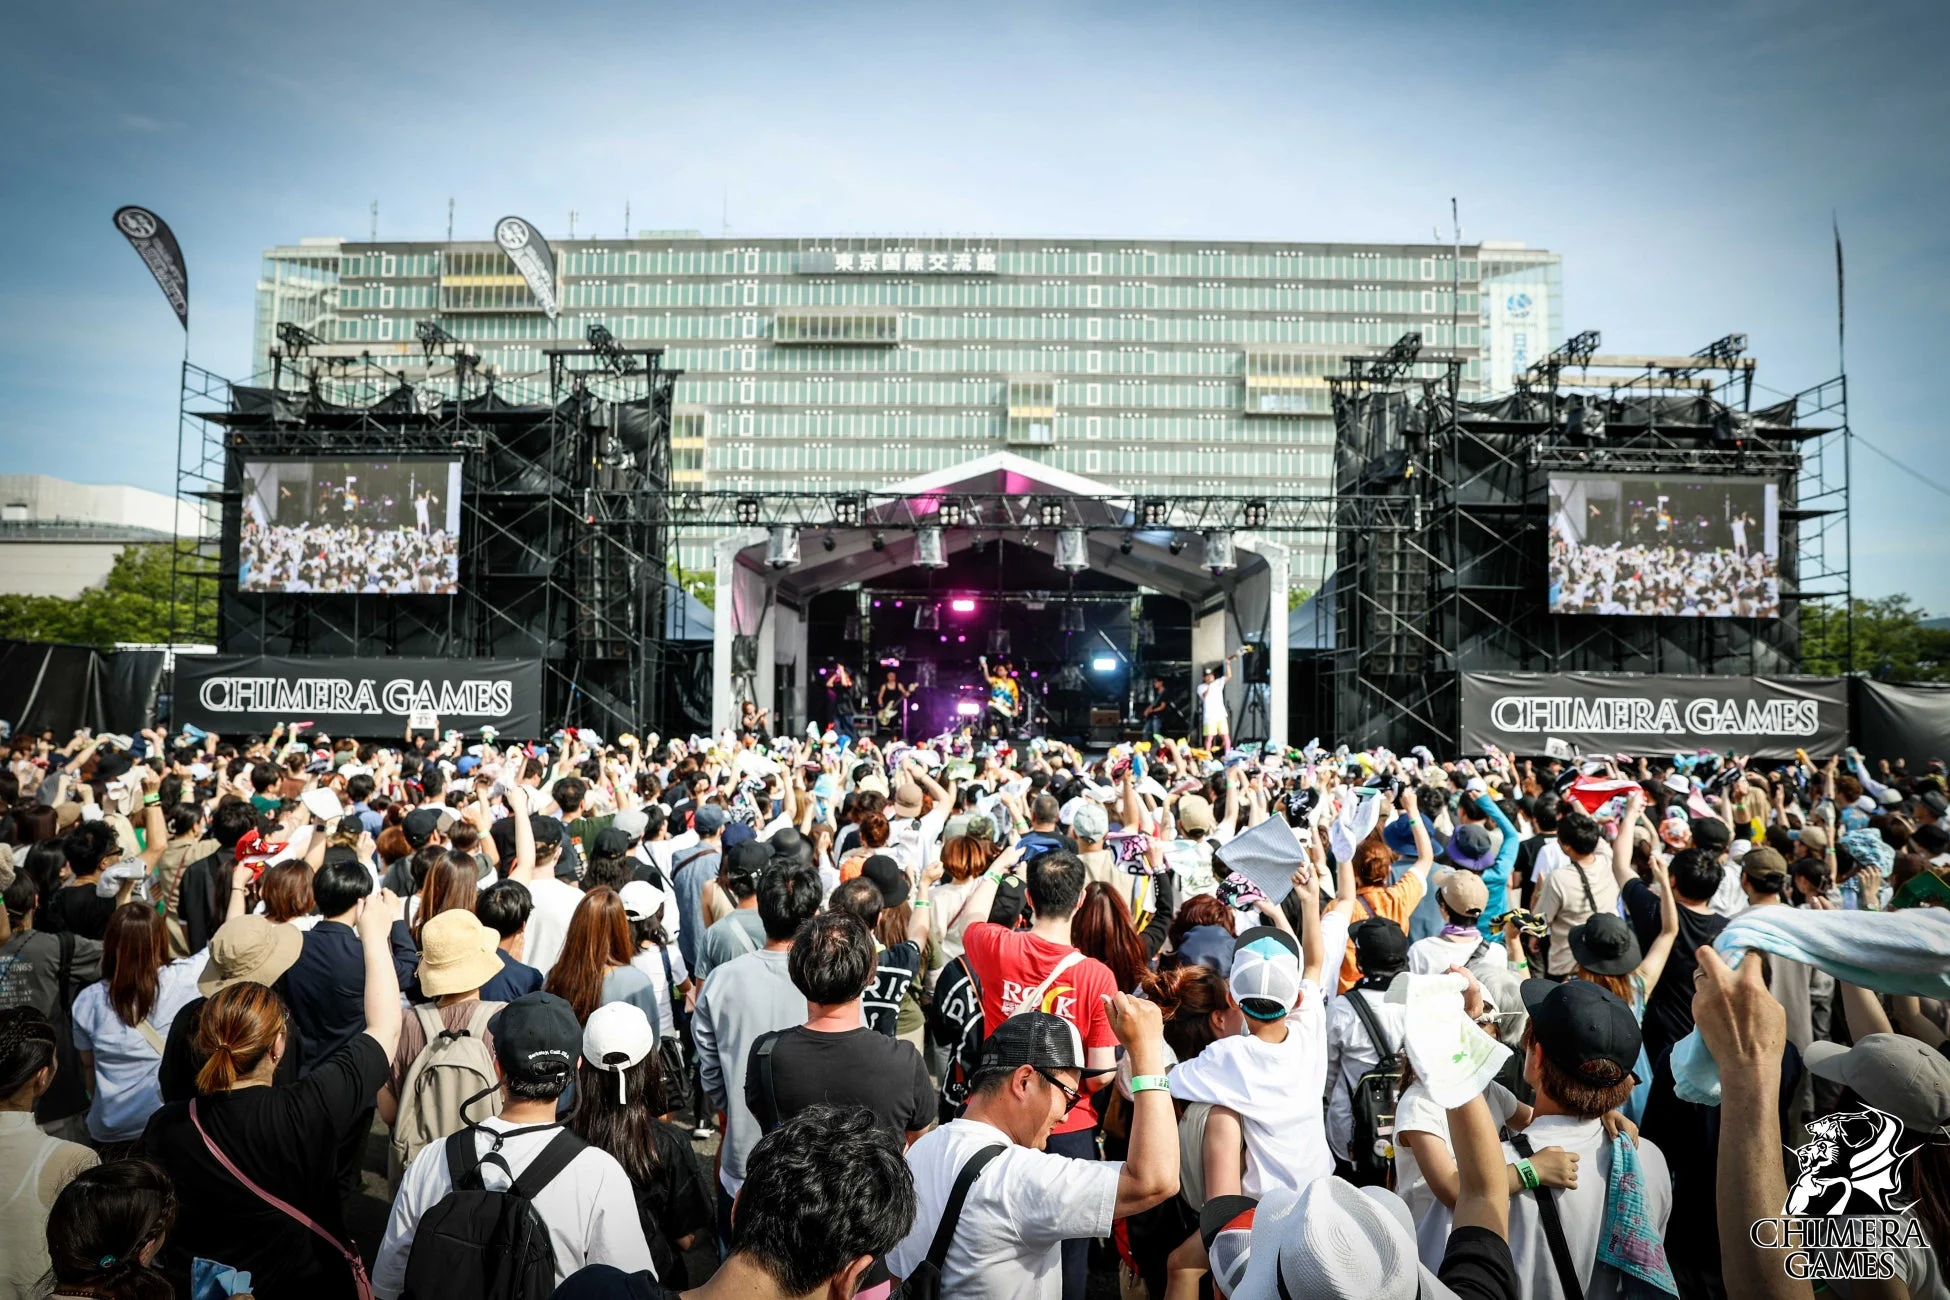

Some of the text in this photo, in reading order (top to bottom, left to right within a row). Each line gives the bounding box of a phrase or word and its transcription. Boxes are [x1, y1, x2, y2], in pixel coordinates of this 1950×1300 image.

[834, 252, 996, 272] 東京国際交流館
[199, 677, 513, 717] CHIMERA GAMES
[1490, 696, 1819, 736] CHIMERA GAMES
